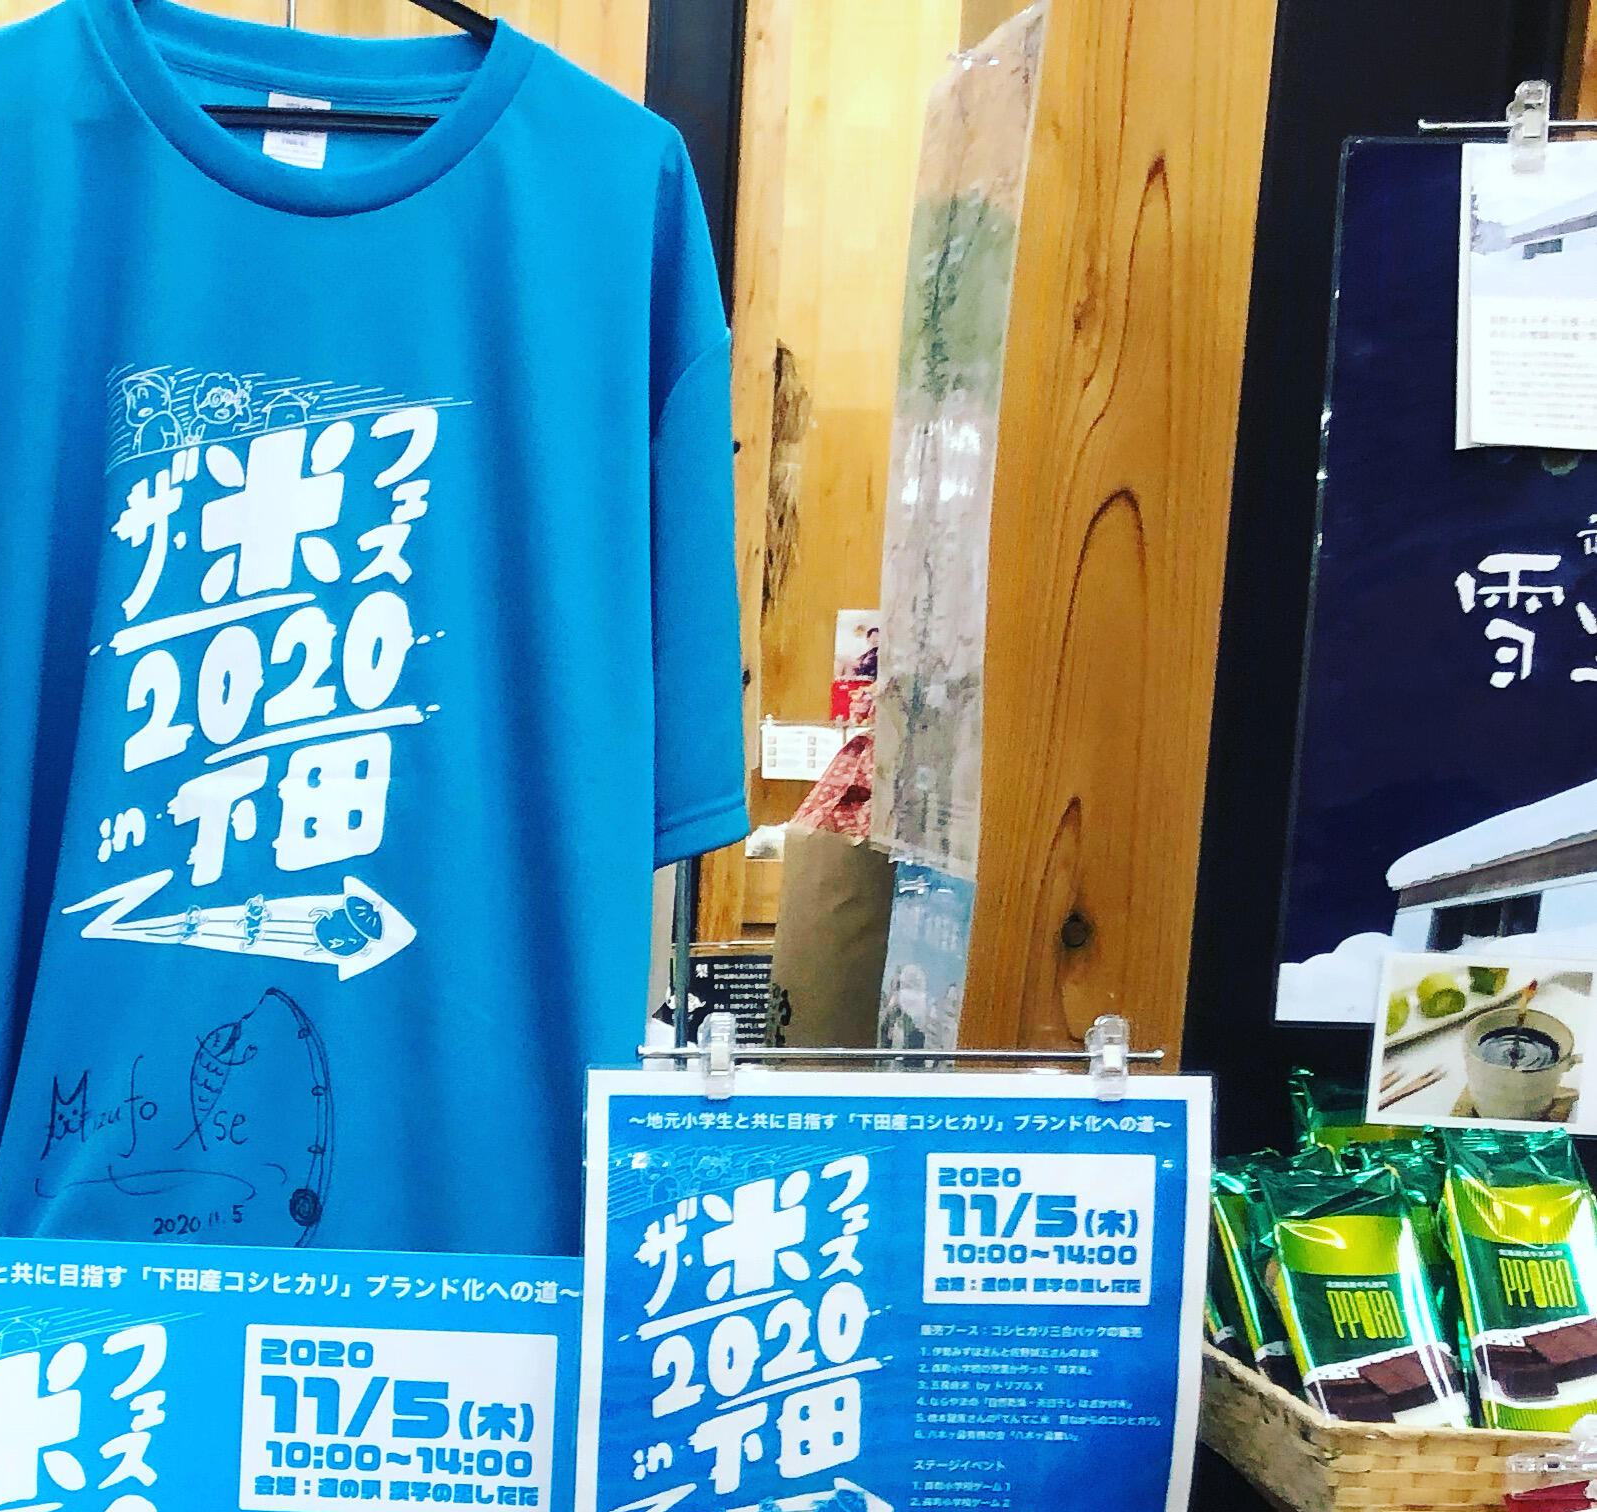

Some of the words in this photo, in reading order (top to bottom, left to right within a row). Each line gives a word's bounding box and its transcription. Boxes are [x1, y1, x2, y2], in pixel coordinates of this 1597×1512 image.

[124, 591, 414, 772] 2020
[98, 807, 145, 862] in
[168, 732, 391, 886] 下田
[938, 1167, 1022, 1188] 2020
[260, 1340, 375, 1368] 2020
[652, 1281, 869, 1419] 2020
[260, 1375, 535, 1443] 11/5(木)
[633, 1443, 674, 1481] in
[690, 1378, 860, 1495] 下田
[266, 1442, 534, 1478] 10:00～14:00
